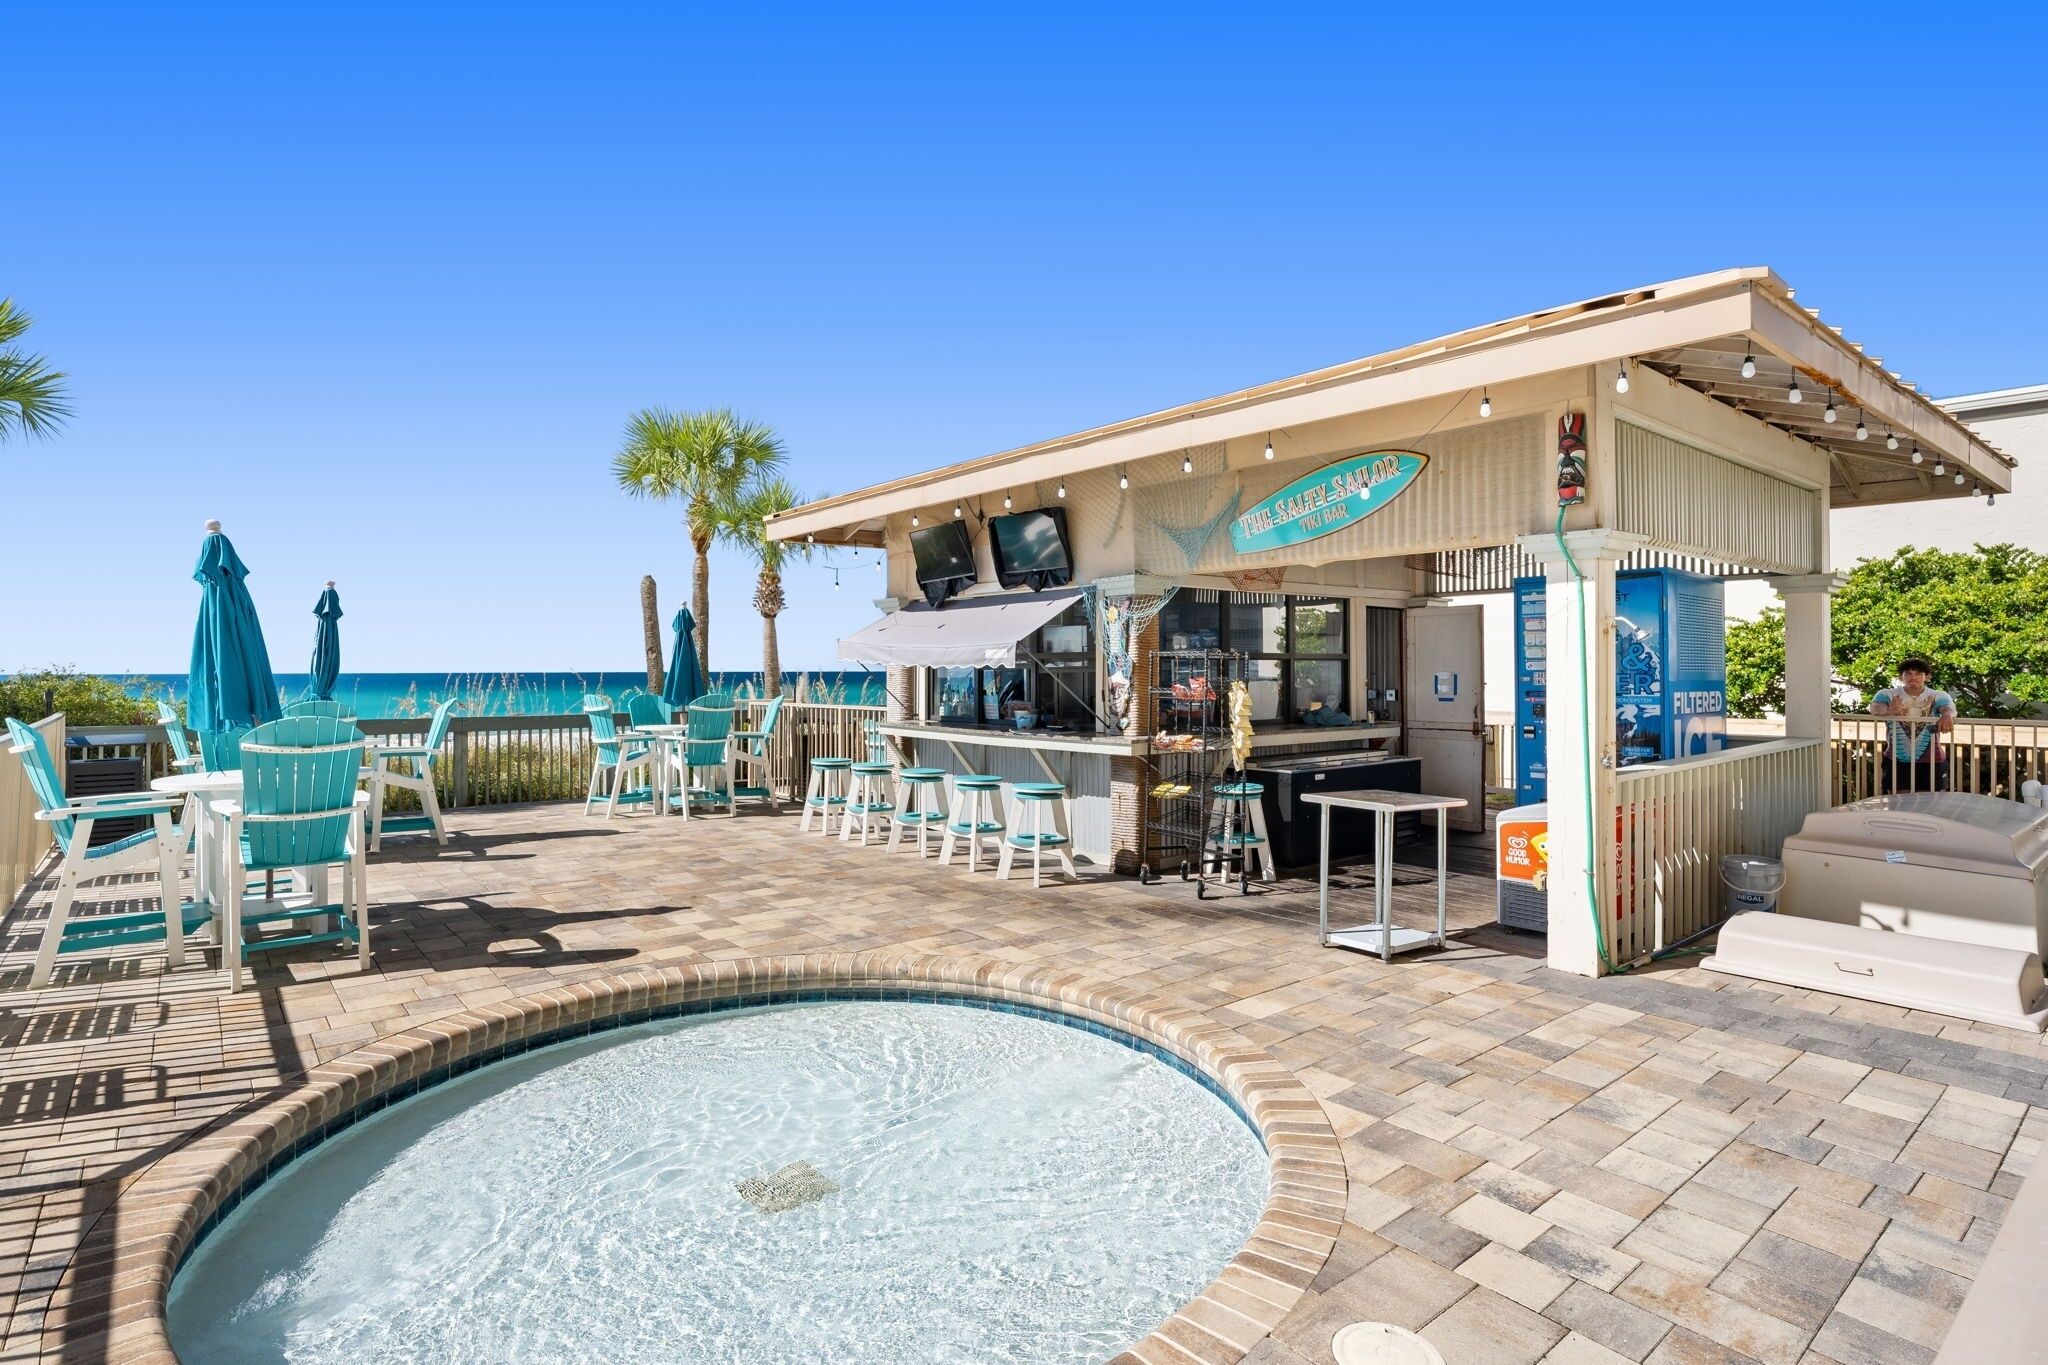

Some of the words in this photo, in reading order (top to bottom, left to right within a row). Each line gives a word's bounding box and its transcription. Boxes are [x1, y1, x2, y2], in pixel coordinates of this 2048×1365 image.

[1240, 507, 1274, 539] THE
[1275, 483, 1328, 523] SALTY
[1332, 455, 1400, 499] SAILOR
[1299, 512, 1322, 532] TIKI
[1323, 503, 1350, 524] BAR
[1674, 691, 1722, 715] FILTERED
[1674, 716, 1723, 759] ICE
[1505, 855, 1530, 866] HUMOR
[1508, 848, 1526, 857] GOOD
